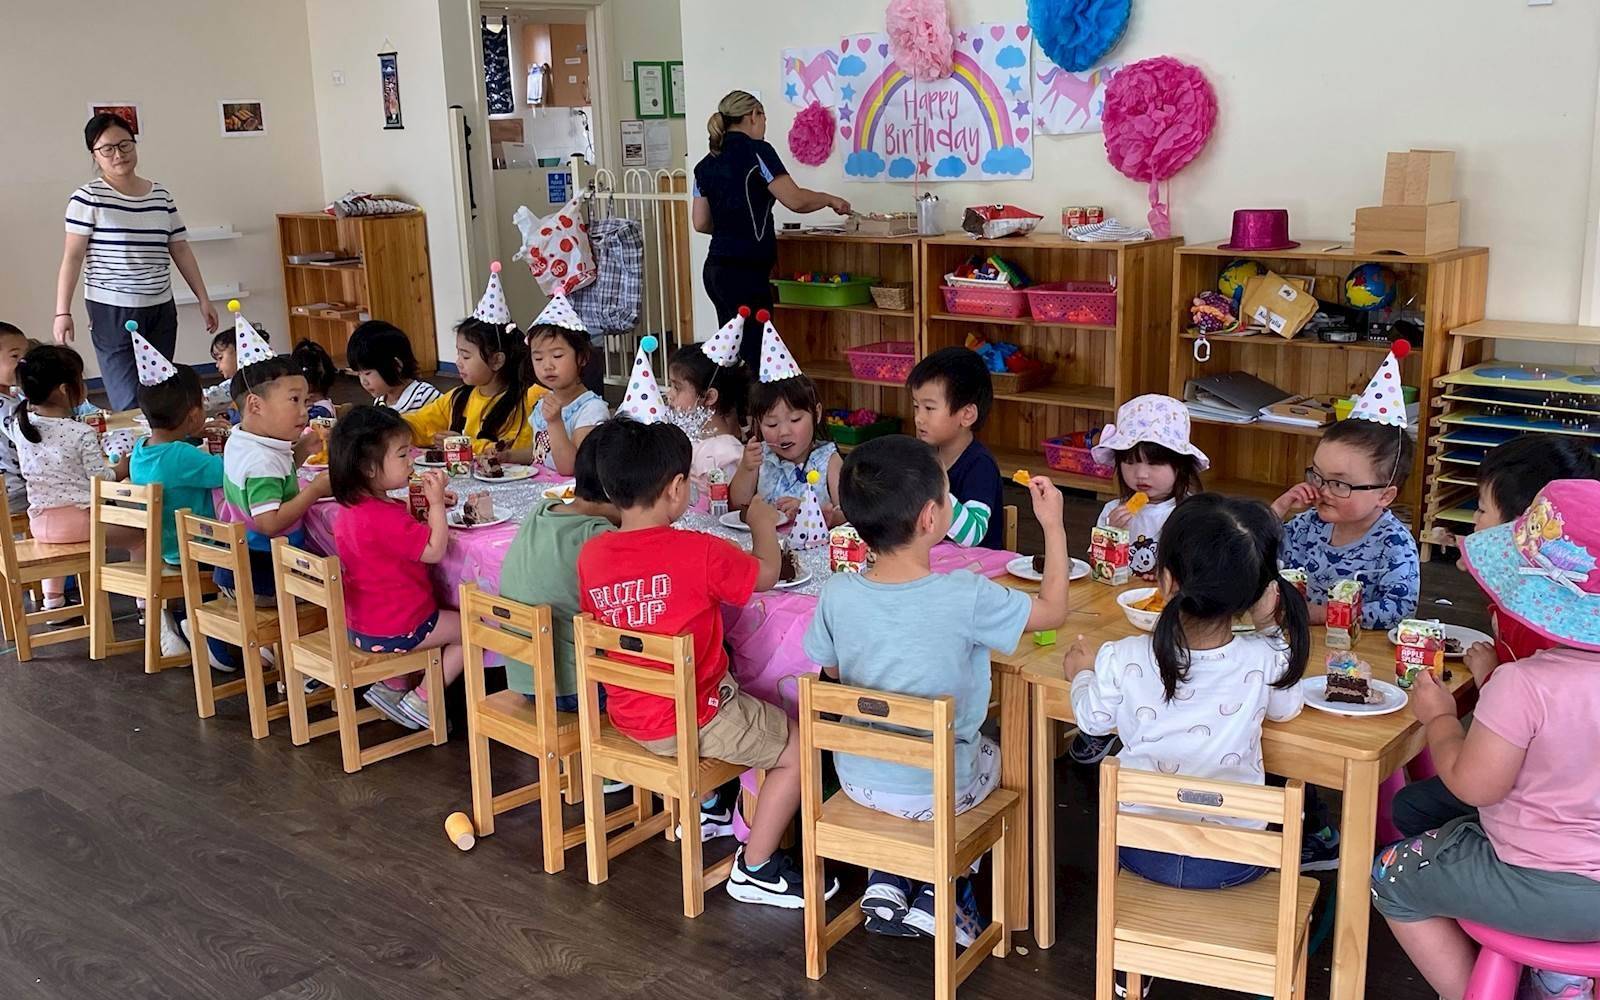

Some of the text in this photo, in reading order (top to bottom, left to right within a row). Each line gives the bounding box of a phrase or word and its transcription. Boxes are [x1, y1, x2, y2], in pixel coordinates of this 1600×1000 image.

[904, 89, 959, 120] Happy
[884, 116, 980, 166] Birthday
[589, 574, 671, 610] BUILD
[626, 600, 667, 628] UP
[1401, 649, 1425, 659] APPLE
